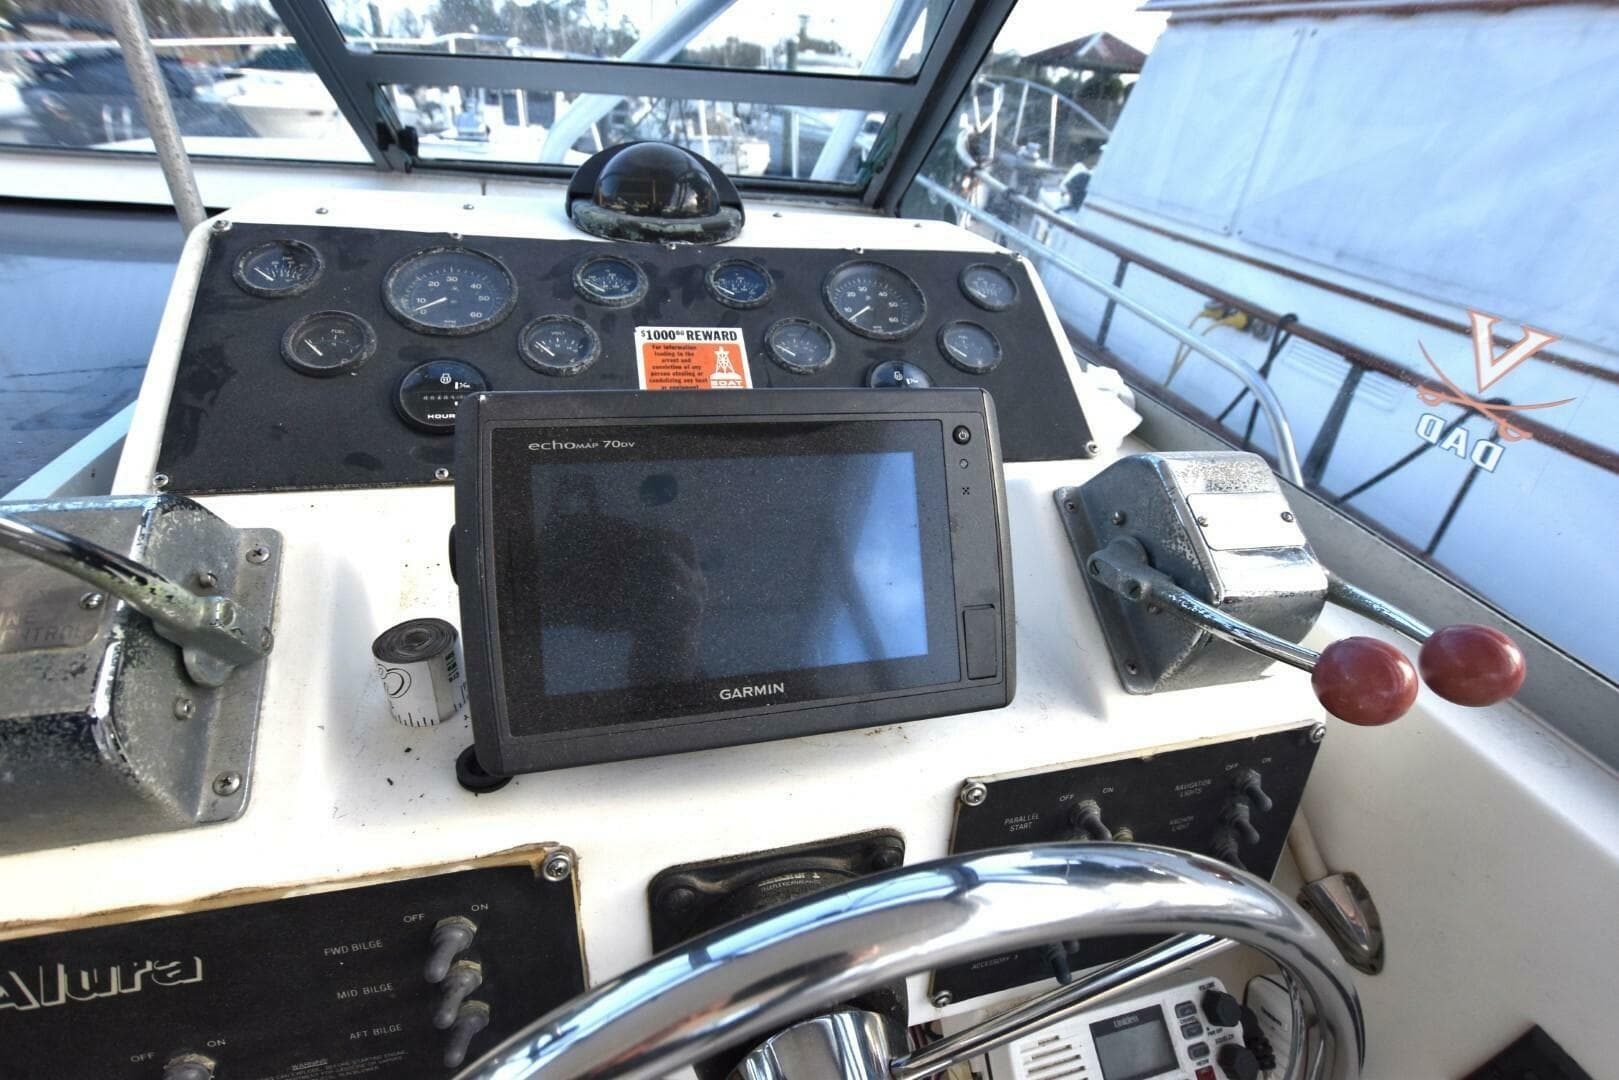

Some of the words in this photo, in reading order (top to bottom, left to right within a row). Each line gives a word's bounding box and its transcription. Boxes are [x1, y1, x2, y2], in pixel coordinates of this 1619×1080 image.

[686, 330, 738, 341] REWARD
[719, 682, 785, 700] GARMIN
[1059, 793, 1075, 802] OFF
[1004, 813, 1040, 825] PARALLEL
[1009, 822, 1033, 832] START
[471, 903, 489, 912] ON
[403, 913, 426, 923] OFF
[324, 945, 349, 957] FWD
[351, 939, 383, 952] BILGE
[336, 989, 359, 1001] MID
[363, 982, 393, 996] BILGE
[350, 1030, 369, 1041] AFT
[373, 1024, 402, 1037] BILGE
[206, 1038, 226, 1048] ON
[130, 1051, 154, 1063] OFF
